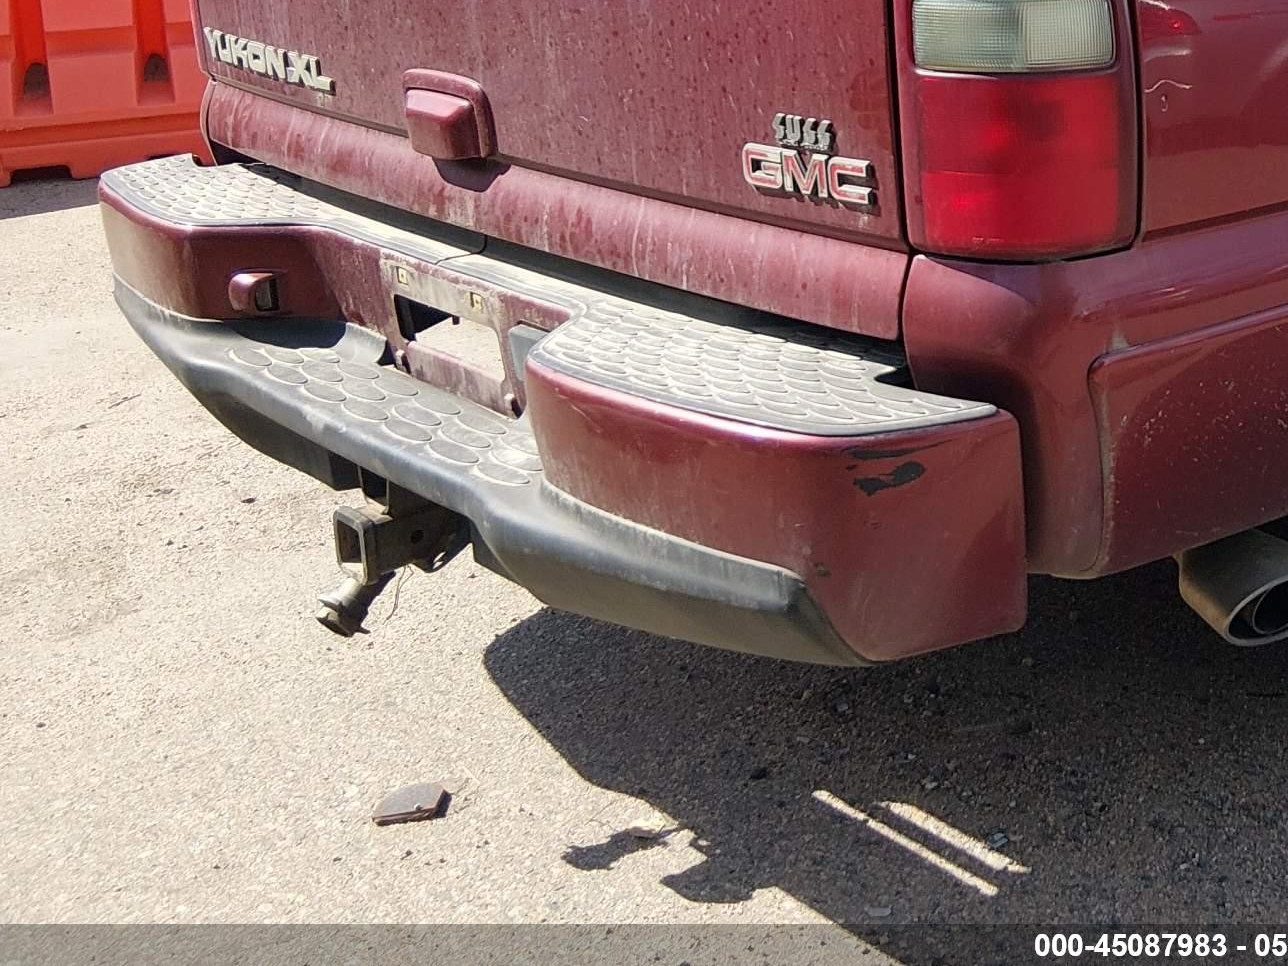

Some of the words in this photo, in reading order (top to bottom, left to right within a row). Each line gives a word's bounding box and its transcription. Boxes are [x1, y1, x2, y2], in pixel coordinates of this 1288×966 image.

[203, 26, 288, 82] YUKON
[286, 50, 335, 95] XL
[742, 142, 873, 205] GMC
